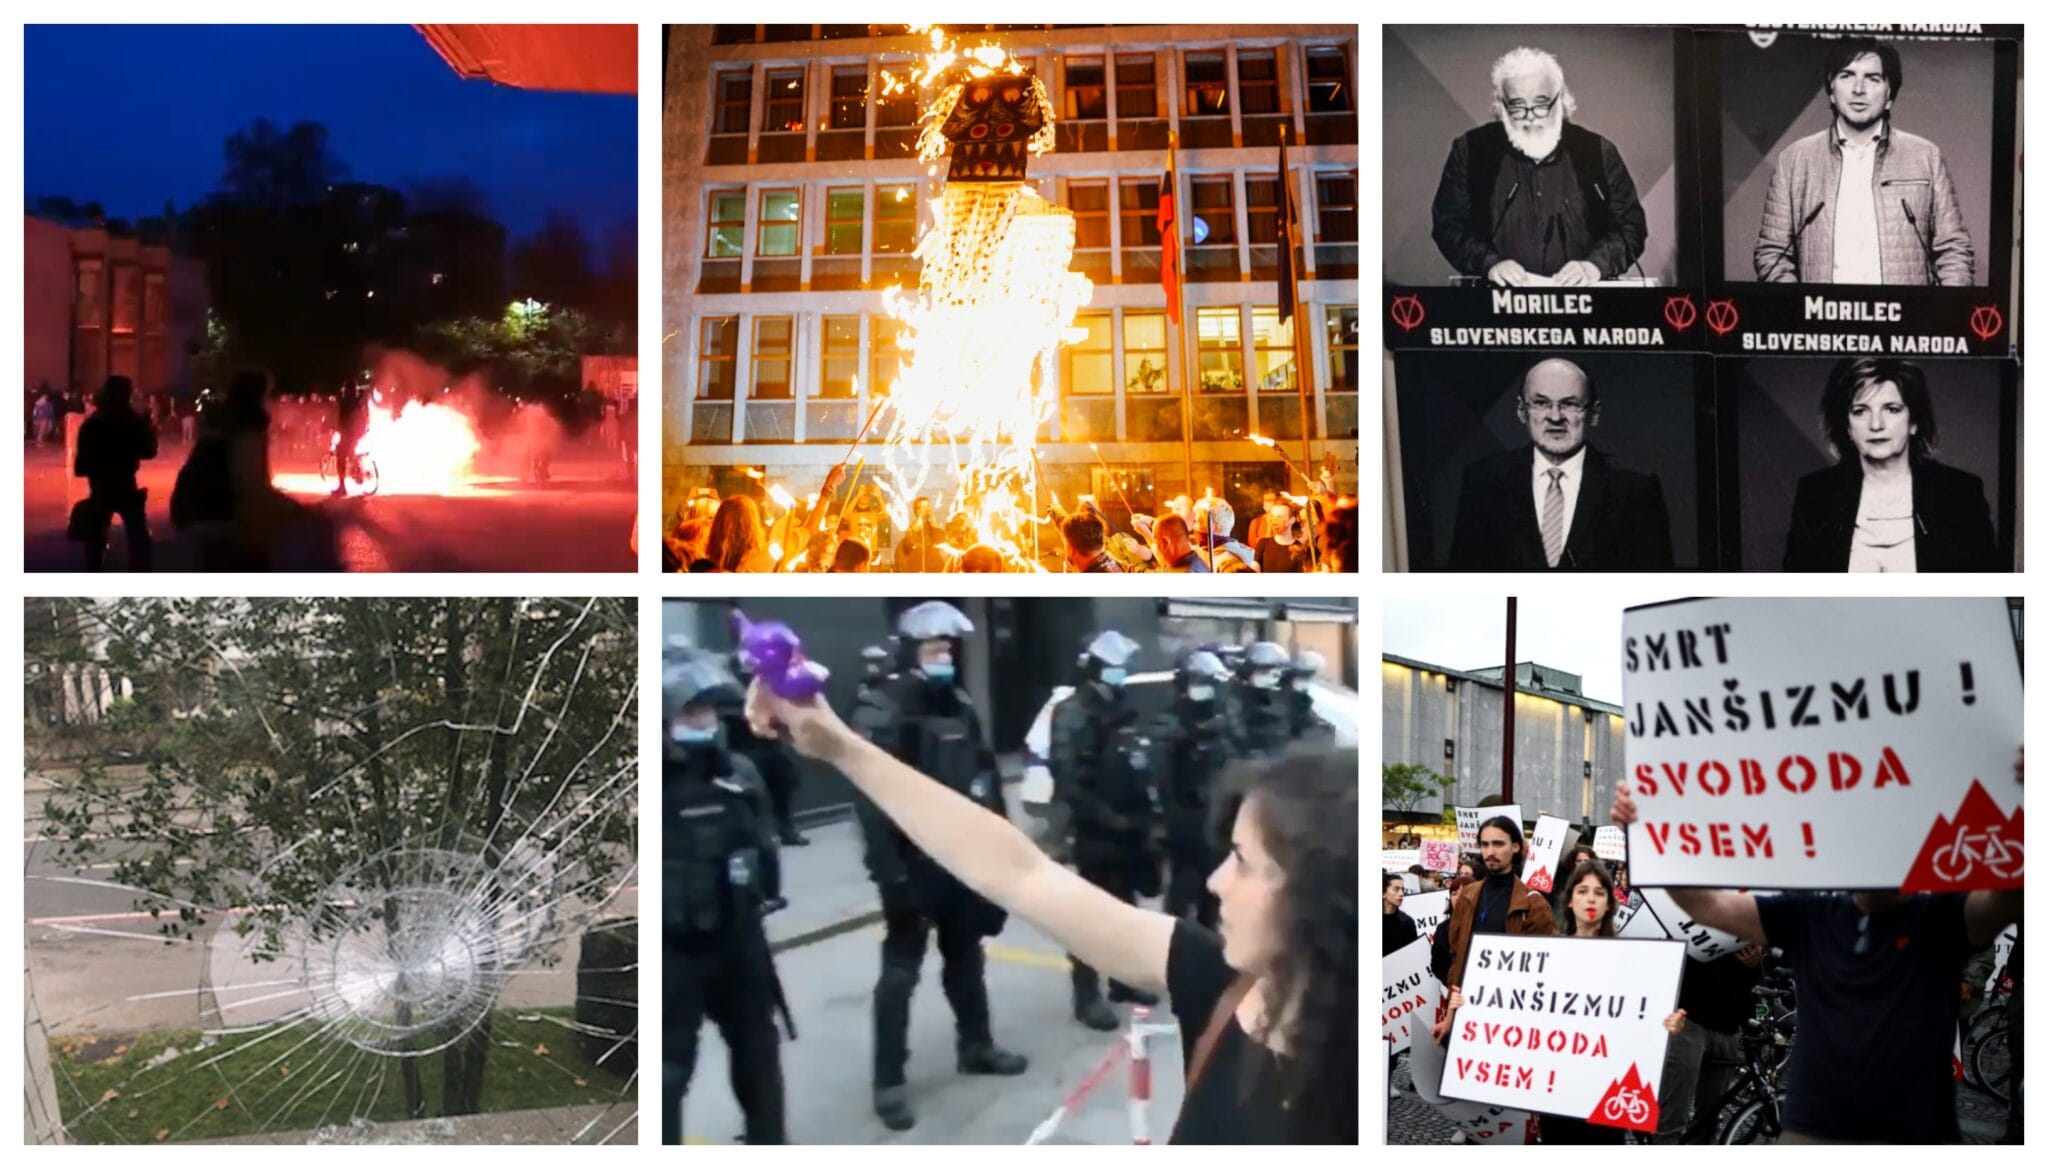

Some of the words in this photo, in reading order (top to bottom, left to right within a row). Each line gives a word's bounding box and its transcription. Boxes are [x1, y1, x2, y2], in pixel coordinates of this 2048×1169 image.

[1430, 327, 1577, 345] SLOVENSKEGA
[1583, 327, 1664, 345] NARODA
[1742, 332, 1884, 352] SLOVENSKEGA
[1890, 336, 1969, 354] NARODA
[1627, 623, 1731, 672] SMRT
[1630, 669, 1921, 738] JANŠIZMU
[1635, 746, 1911, 796] SVOBODA
[1645, 822, 1774, 859] VSEM
[1477, 949, 1550, 974] SMRT
[1382, 972, 1421, 1003] ZMU
[1469, 982, 1625, 1019] JANŠIZMU
[1462, 1020, 1608, 1058] SVOBODA
[1456, 1057, 1534, 1090] VSEM
